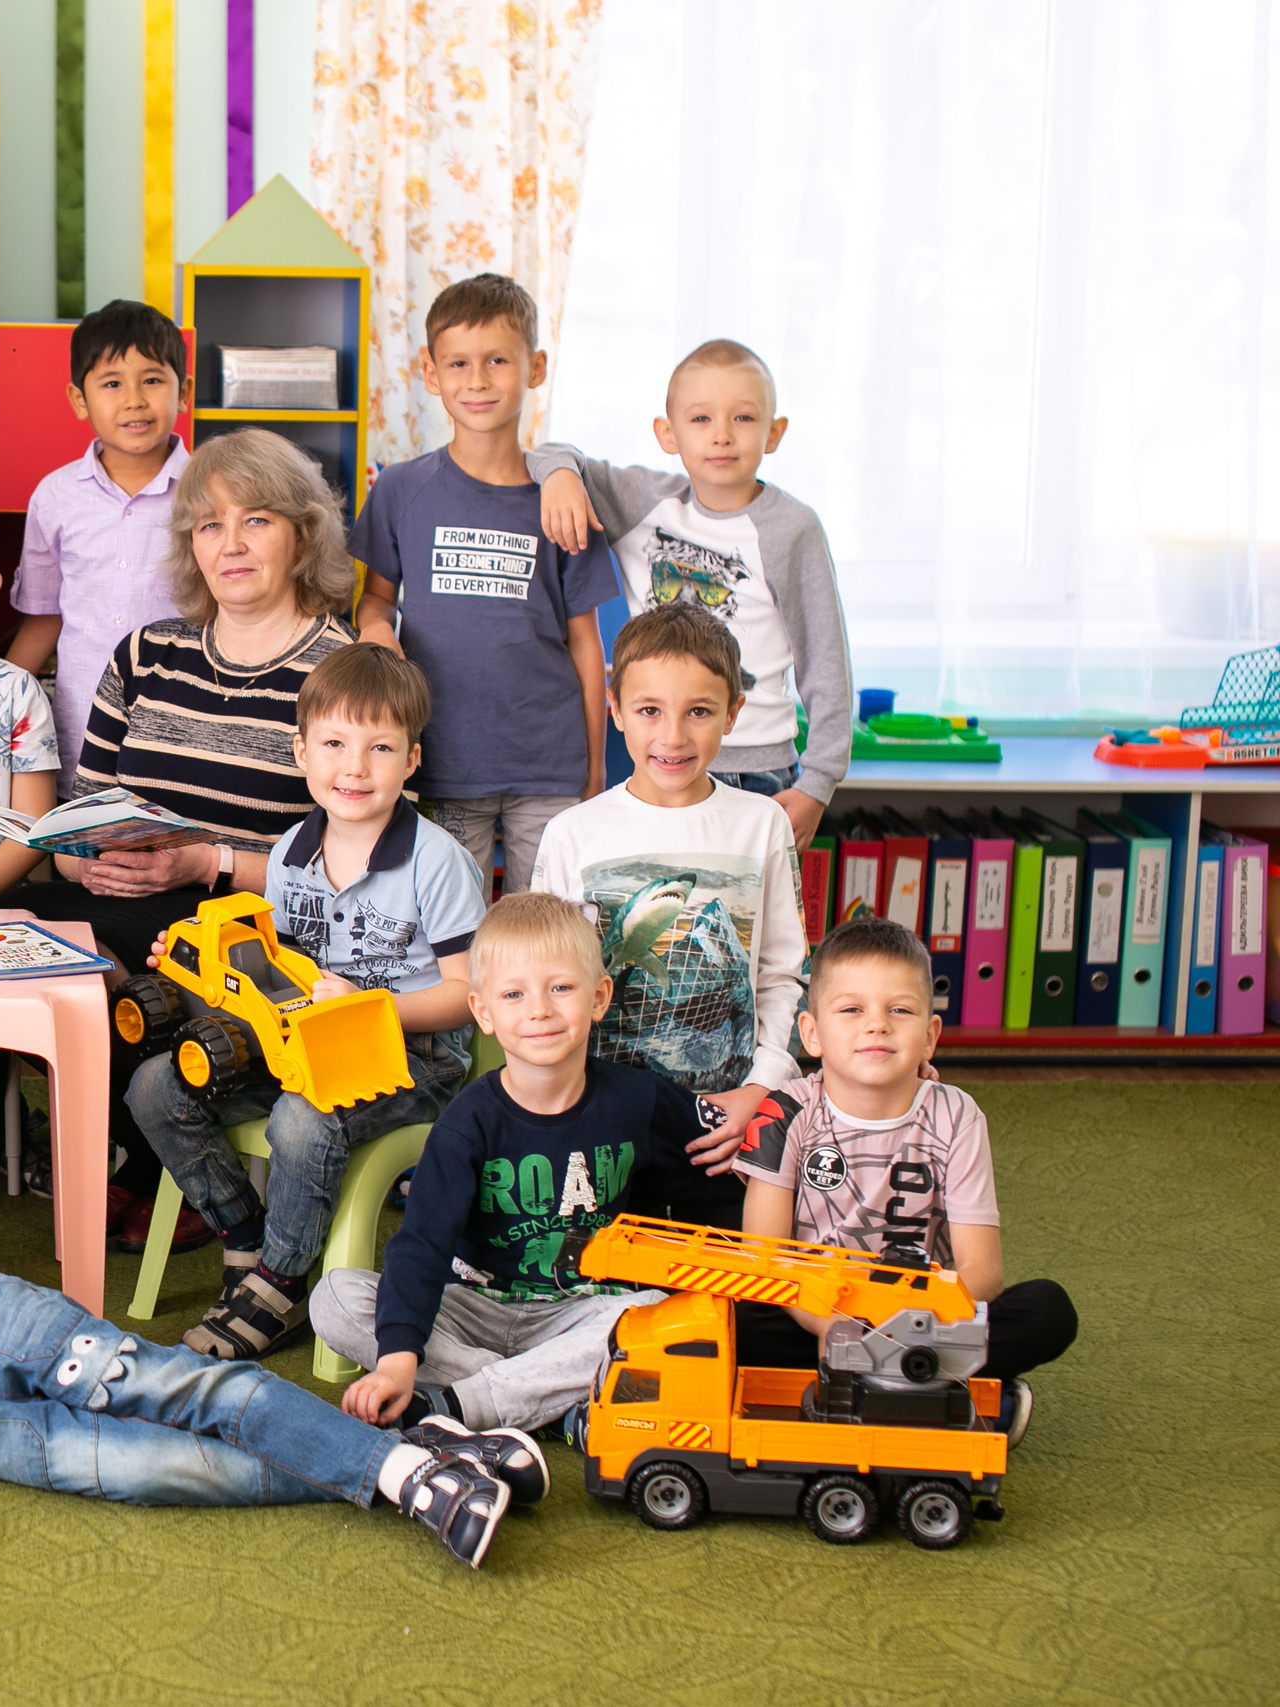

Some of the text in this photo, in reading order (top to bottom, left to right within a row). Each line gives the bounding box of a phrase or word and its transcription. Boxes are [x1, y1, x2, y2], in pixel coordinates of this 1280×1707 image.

[443, 530, 531, 550] FROM NOTHING
[440, 553, 527, 574] TO SOMETHING
[438, 577, 524, 596] TO EVERYTHING
[382, 919, 398, 930] PUT
[387, 941, 396, 950] TO
[366, 959, 398, 970] RIGGED
[398, 961, 420, 975] SHIP
[226, 976, 239, 991] CAT
[480, 1141, 635, 1217] ROAM
[816, 1175, 833, 1185] EET
[508, 1212, 613, 1242] SINCE 1982
[616, 1418, 656, 1430] ПОЛЕСЬЕ
